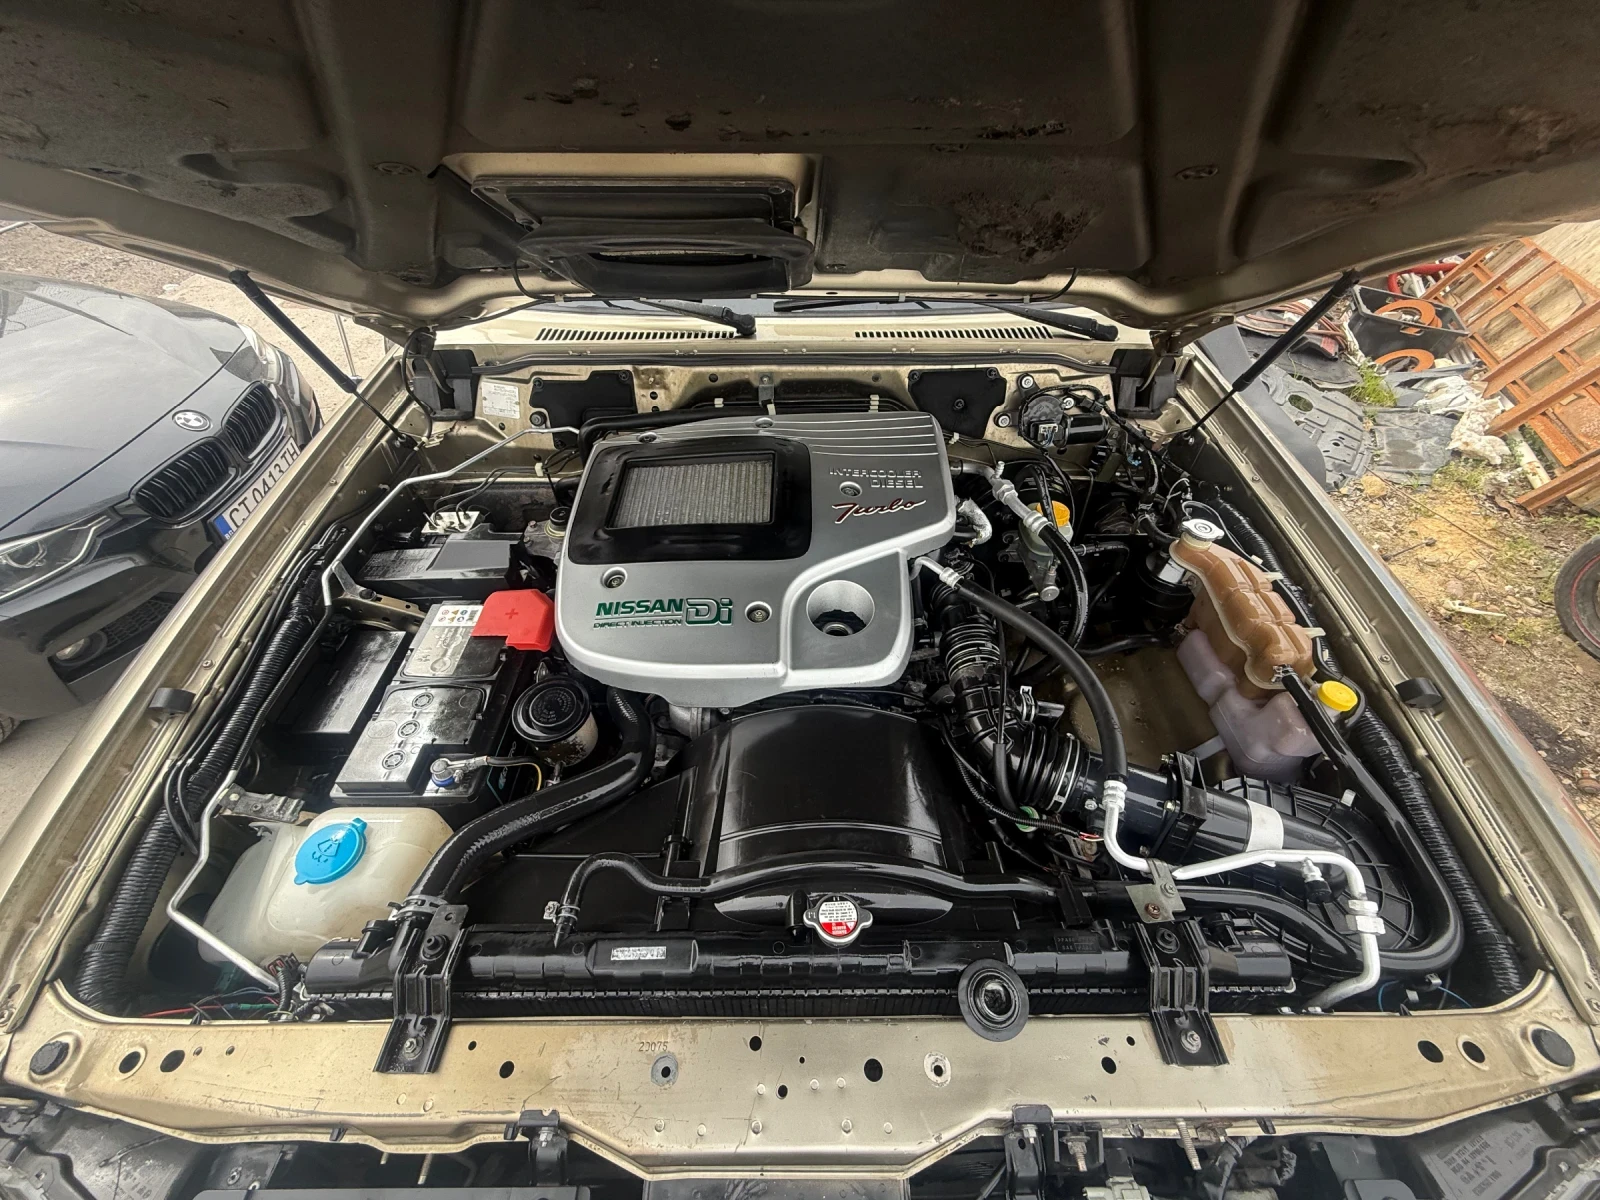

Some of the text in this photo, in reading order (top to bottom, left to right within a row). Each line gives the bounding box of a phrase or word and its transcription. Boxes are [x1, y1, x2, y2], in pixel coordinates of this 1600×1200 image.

[828, 467, 922, 478] INTERCOOLER
[229, 441, 300, 529] CT 0413 TH
[870, 479, 924, 489] DIESEL
[831, 498, 927, 524] Turbo
[595, 597, 733, 626] NISSAN Di
[593, 618, 683, 630] DIRECT INJECTION
